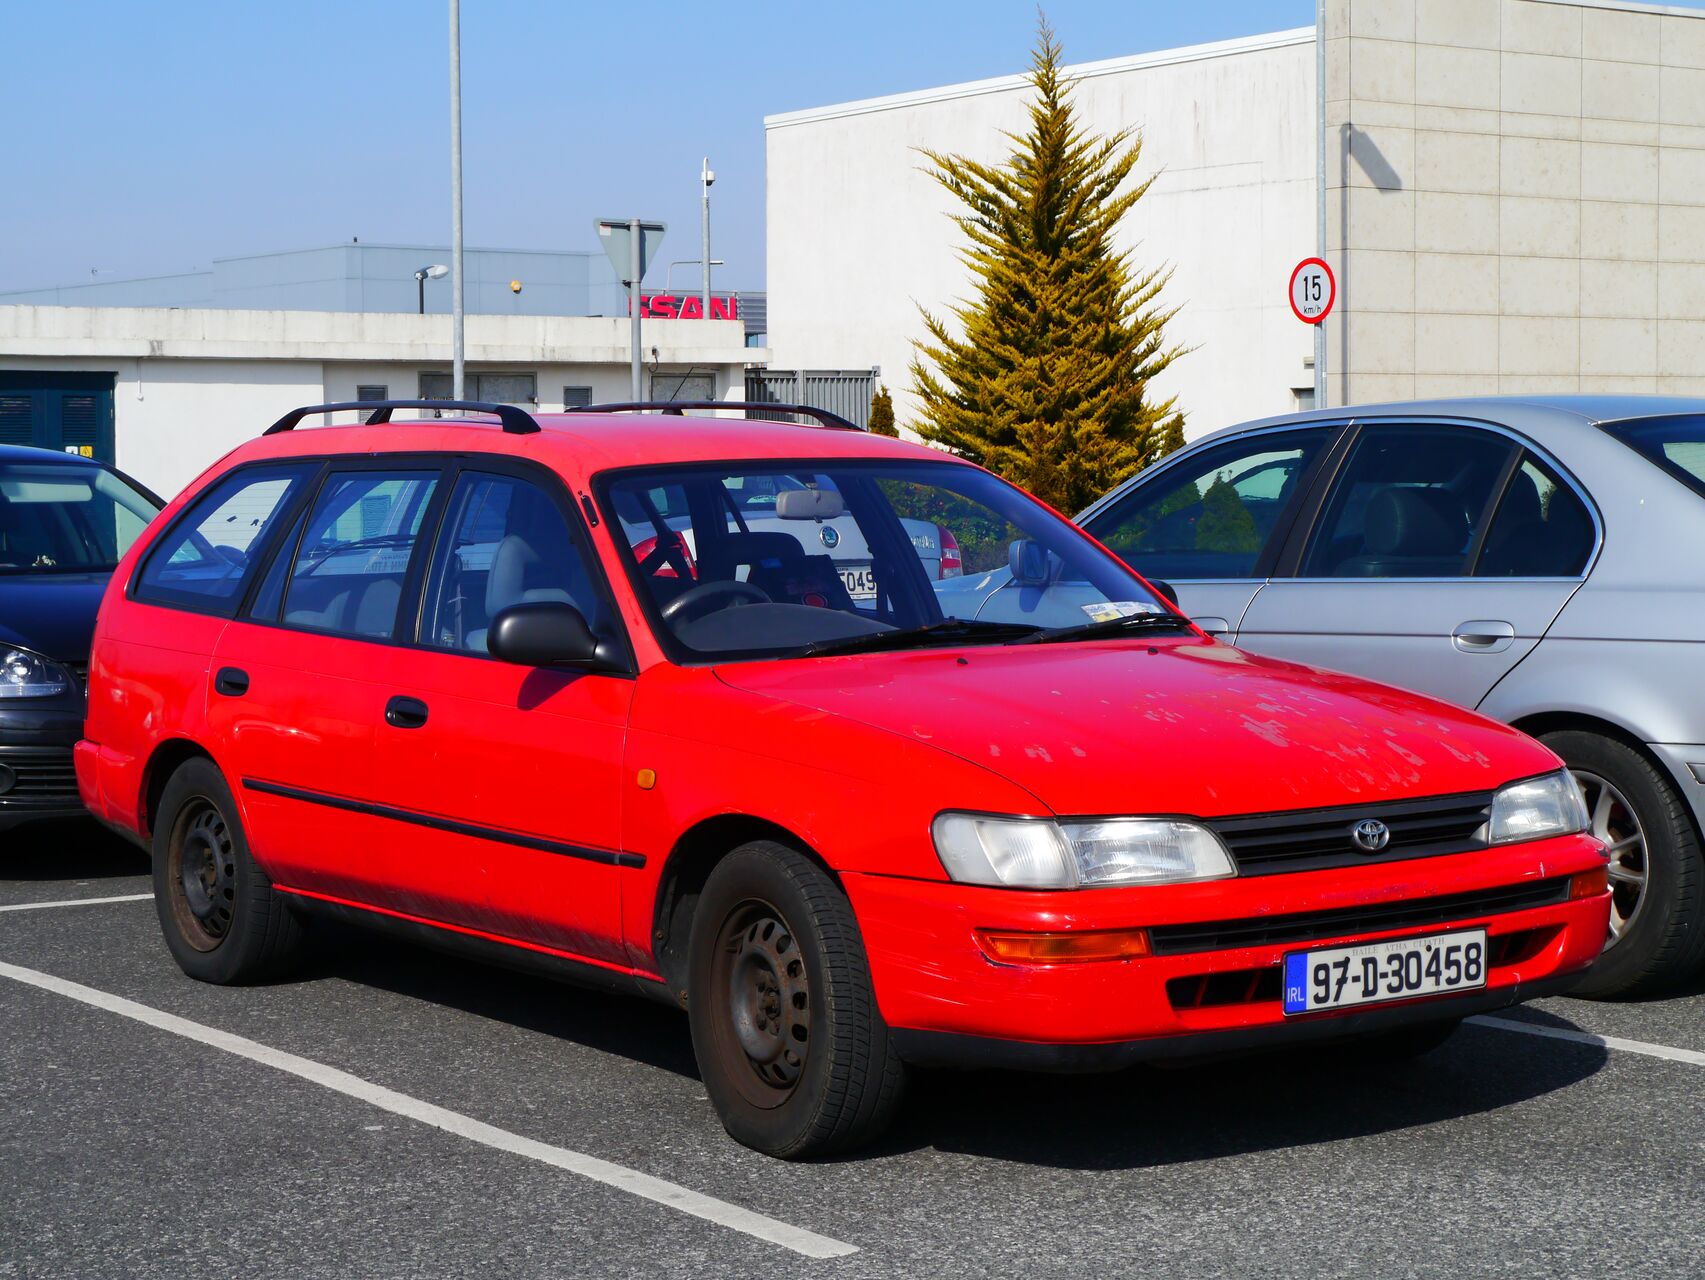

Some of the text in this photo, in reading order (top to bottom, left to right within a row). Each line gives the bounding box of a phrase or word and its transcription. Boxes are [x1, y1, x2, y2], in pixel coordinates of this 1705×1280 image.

[1303, 275, 1321, 301] 15
[1303, 305, 1321, 314] km/h
[1313, 942, 1482, 1005] 97-D-30458
[1287, 986, 1305, 1003] IRL
